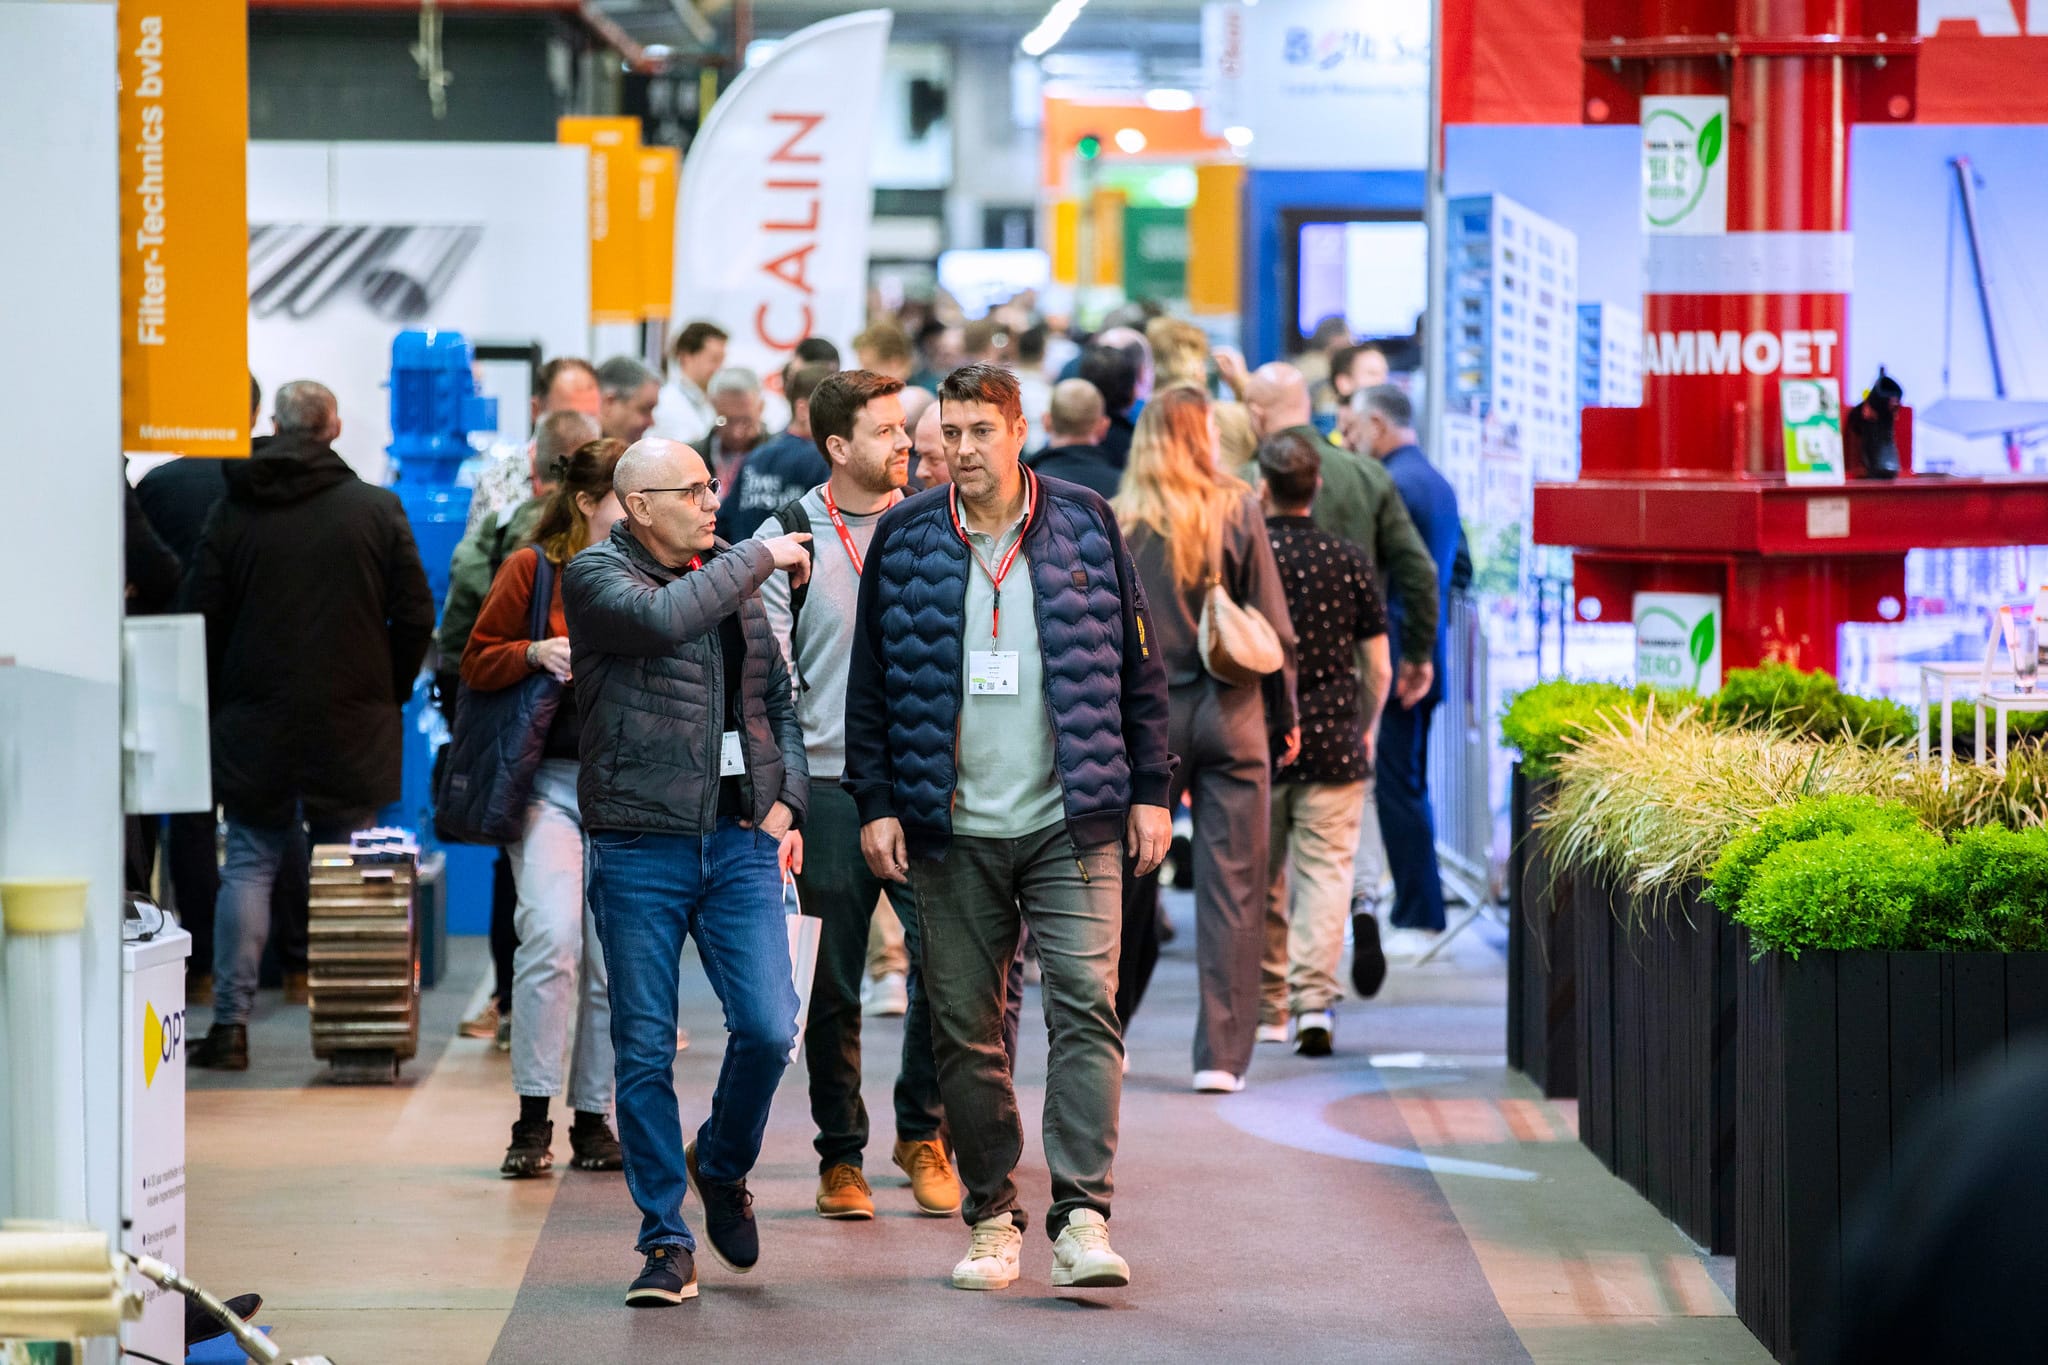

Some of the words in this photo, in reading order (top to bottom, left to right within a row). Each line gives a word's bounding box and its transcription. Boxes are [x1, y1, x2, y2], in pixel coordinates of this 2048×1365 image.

[135, 16, 163, 97] bvba
[137, 106, 166, 345] Filter-Technics
[139, 424, 238, 441] Maintenance
